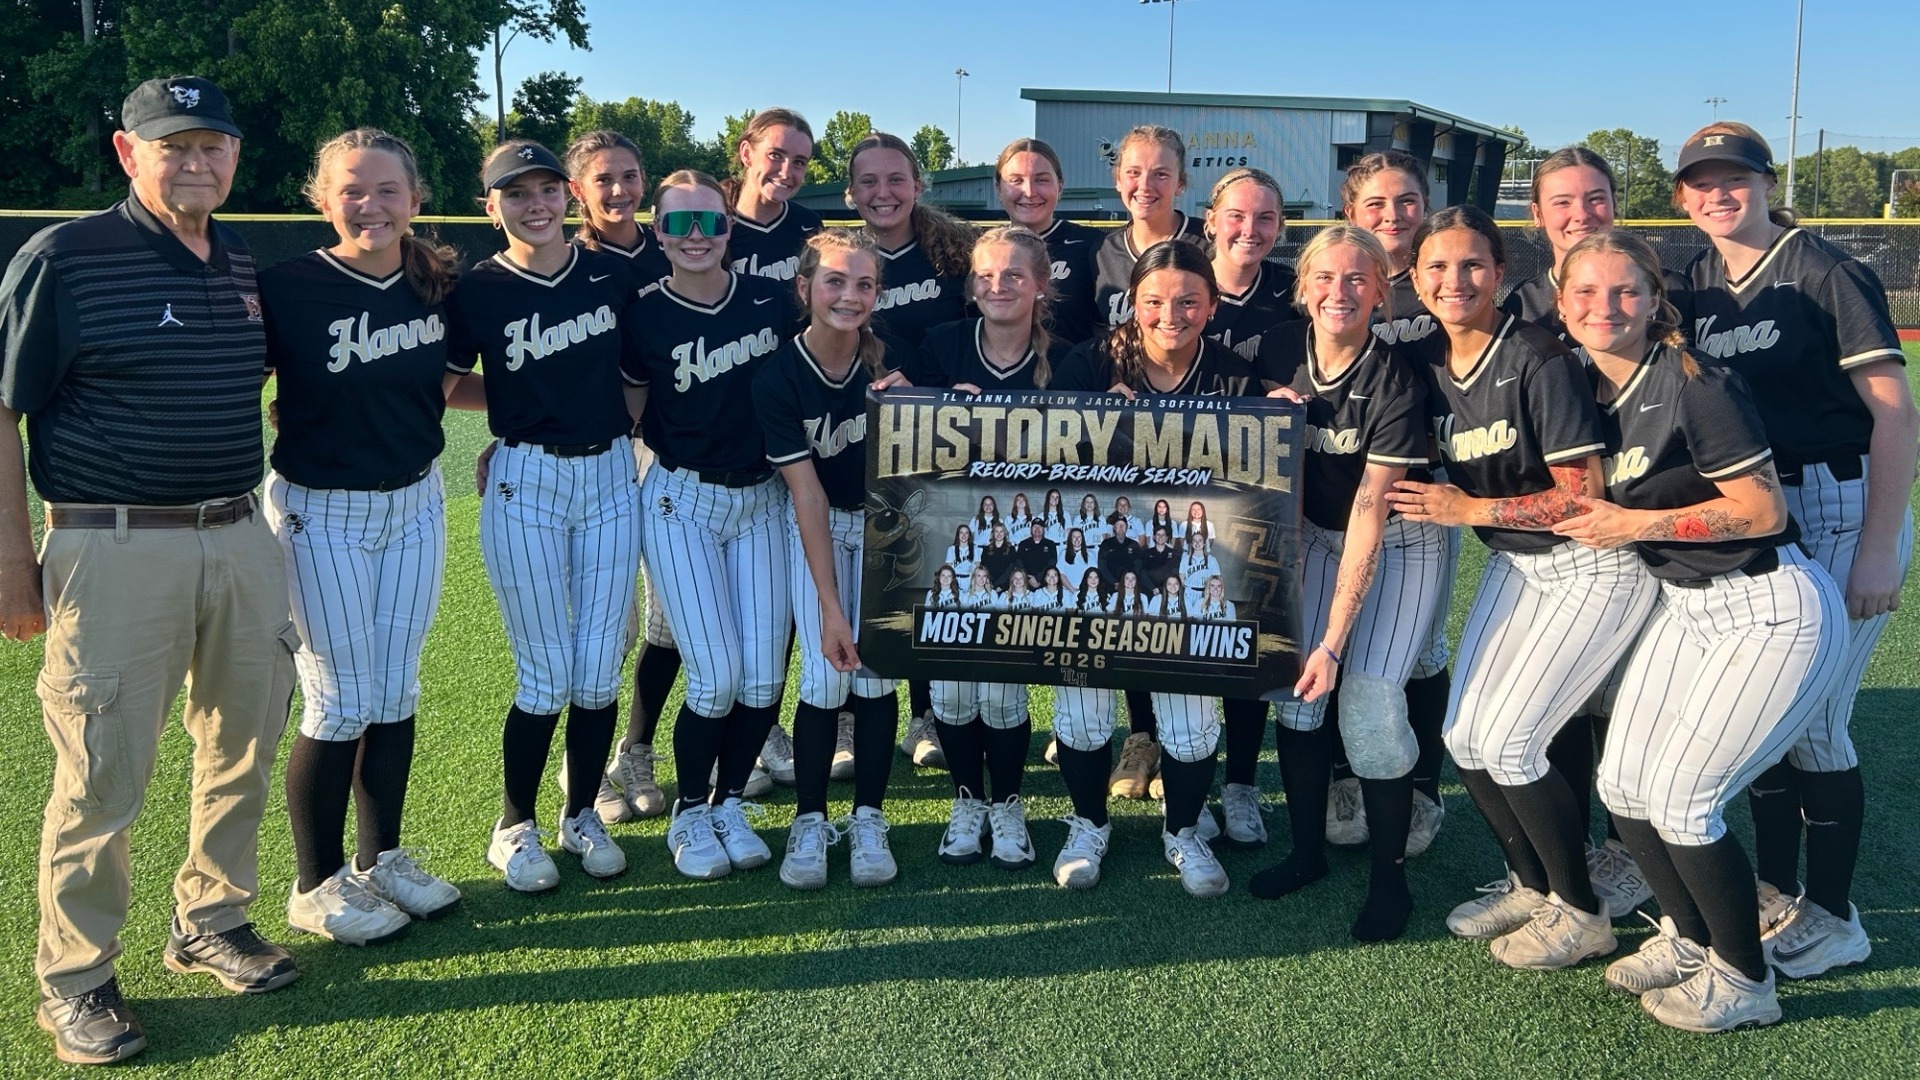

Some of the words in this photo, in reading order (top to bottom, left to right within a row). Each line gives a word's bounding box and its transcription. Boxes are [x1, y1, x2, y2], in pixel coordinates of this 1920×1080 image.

[1186, 131, 1257, 149] ANNA
[1192, 156, 1248, 167] ETICS
[872, 279, 941, 312] anna
[326, 311, 445, 373] Hanna
[504, 305, 617, 372] Hanna
[1371, 314, 1438, 346] nna
[671, 327, 779, 393] Hanna
[942, 392, 957, 402] TL
[965, 393, 1013, 404] HANNA
[1021, 395, 1078, 406] YELLOW
[1085, 397, 1151, 408] JACKETS
[1159, 399, 1232, 410] SOFTBALL
[802, 412, 867, 459] Hann
[877, 403, 1122, 479] HISTORY
[1132, 410, 1292, 494] MADE
[969, 461, 1139, 483] RECORD-BREAKING
[1138, 467, 1213, 487] SEASON
[920, 611, 991, 645] MOST
[994, 613, 1083, 649] SINGLE
[1087, 617, 1185, 655] SEASON
[1189, 623, 1253, 660] WINS
[1043, 651, 1106, 669] 2026
